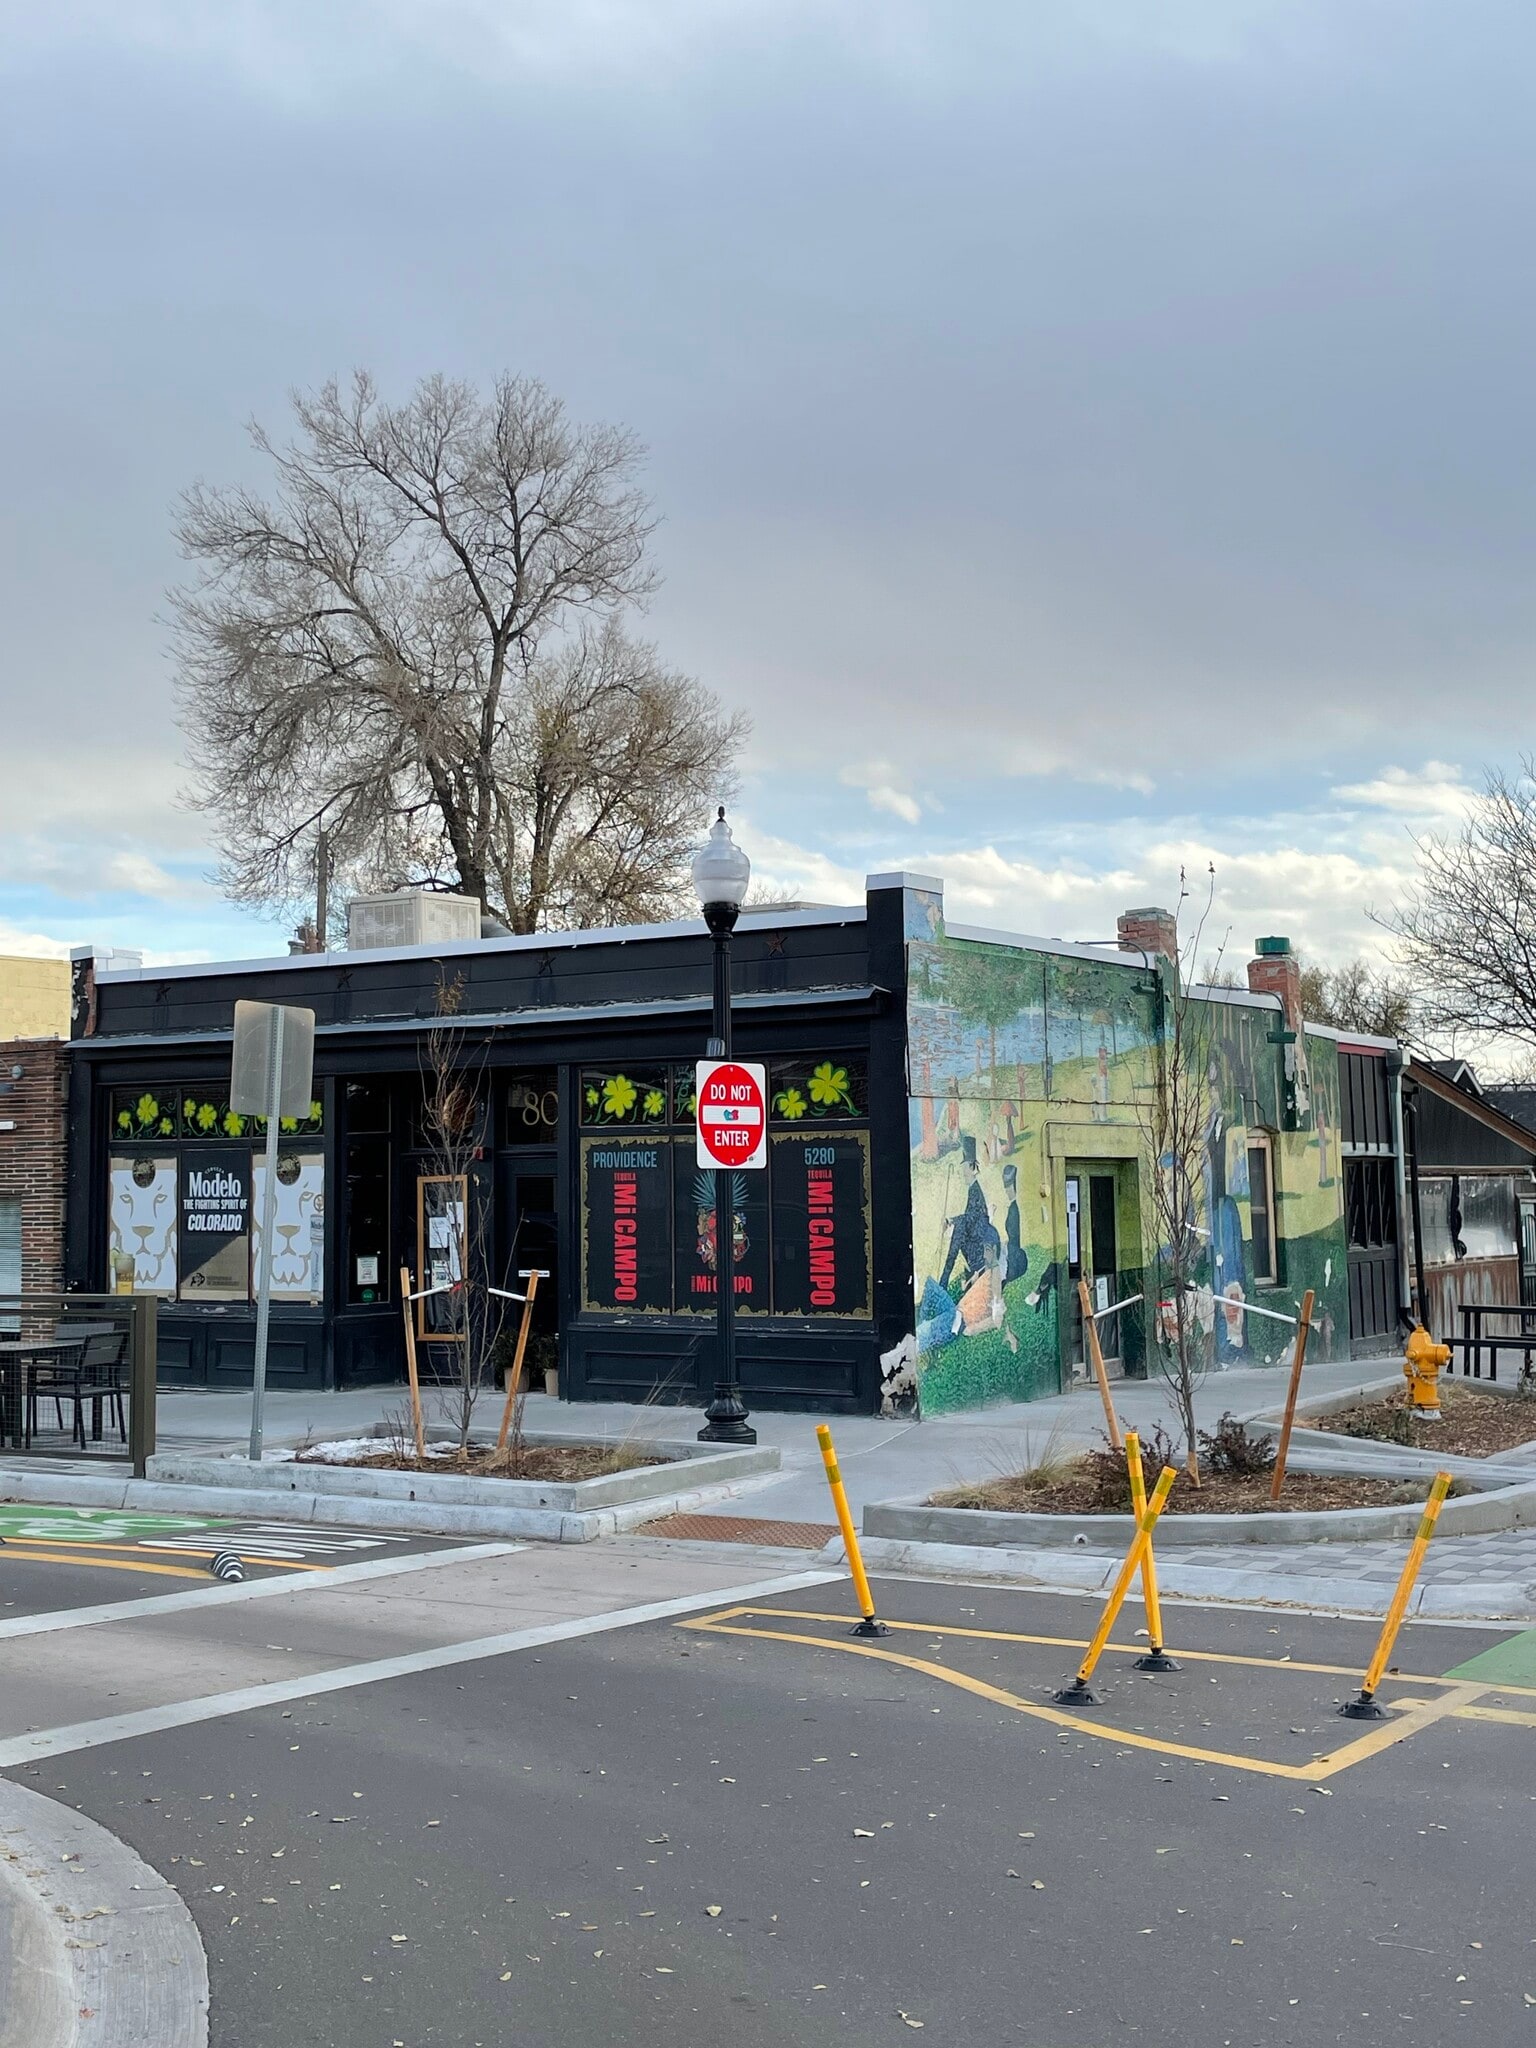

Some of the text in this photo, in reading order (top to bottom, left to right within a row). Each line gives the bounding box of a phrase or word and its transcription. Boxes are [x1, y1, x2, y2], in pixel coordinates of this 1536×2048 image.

[710, 1083, 752, 1102] DO NOT
[714, 1129, 750, 1147] ENTER
[593, 1150, 657, 1170] PROVIDENCE
[804, 1147, 835, 1166] 5280
[807, 1169, 833, 1180] TEQUILA
[189, 1171, 242, 1198] Modelo
[183, 1199, 248, 1210] THE FIGHTING SPIRIT OF
[613, 1183, 638, 1302] Mi CAMPO
[807, 1181, 836, 1307] Mi CAMPO
[696, 1275, 712, 1293] Mi
[138, 1525, 411, 1559] ONLY
